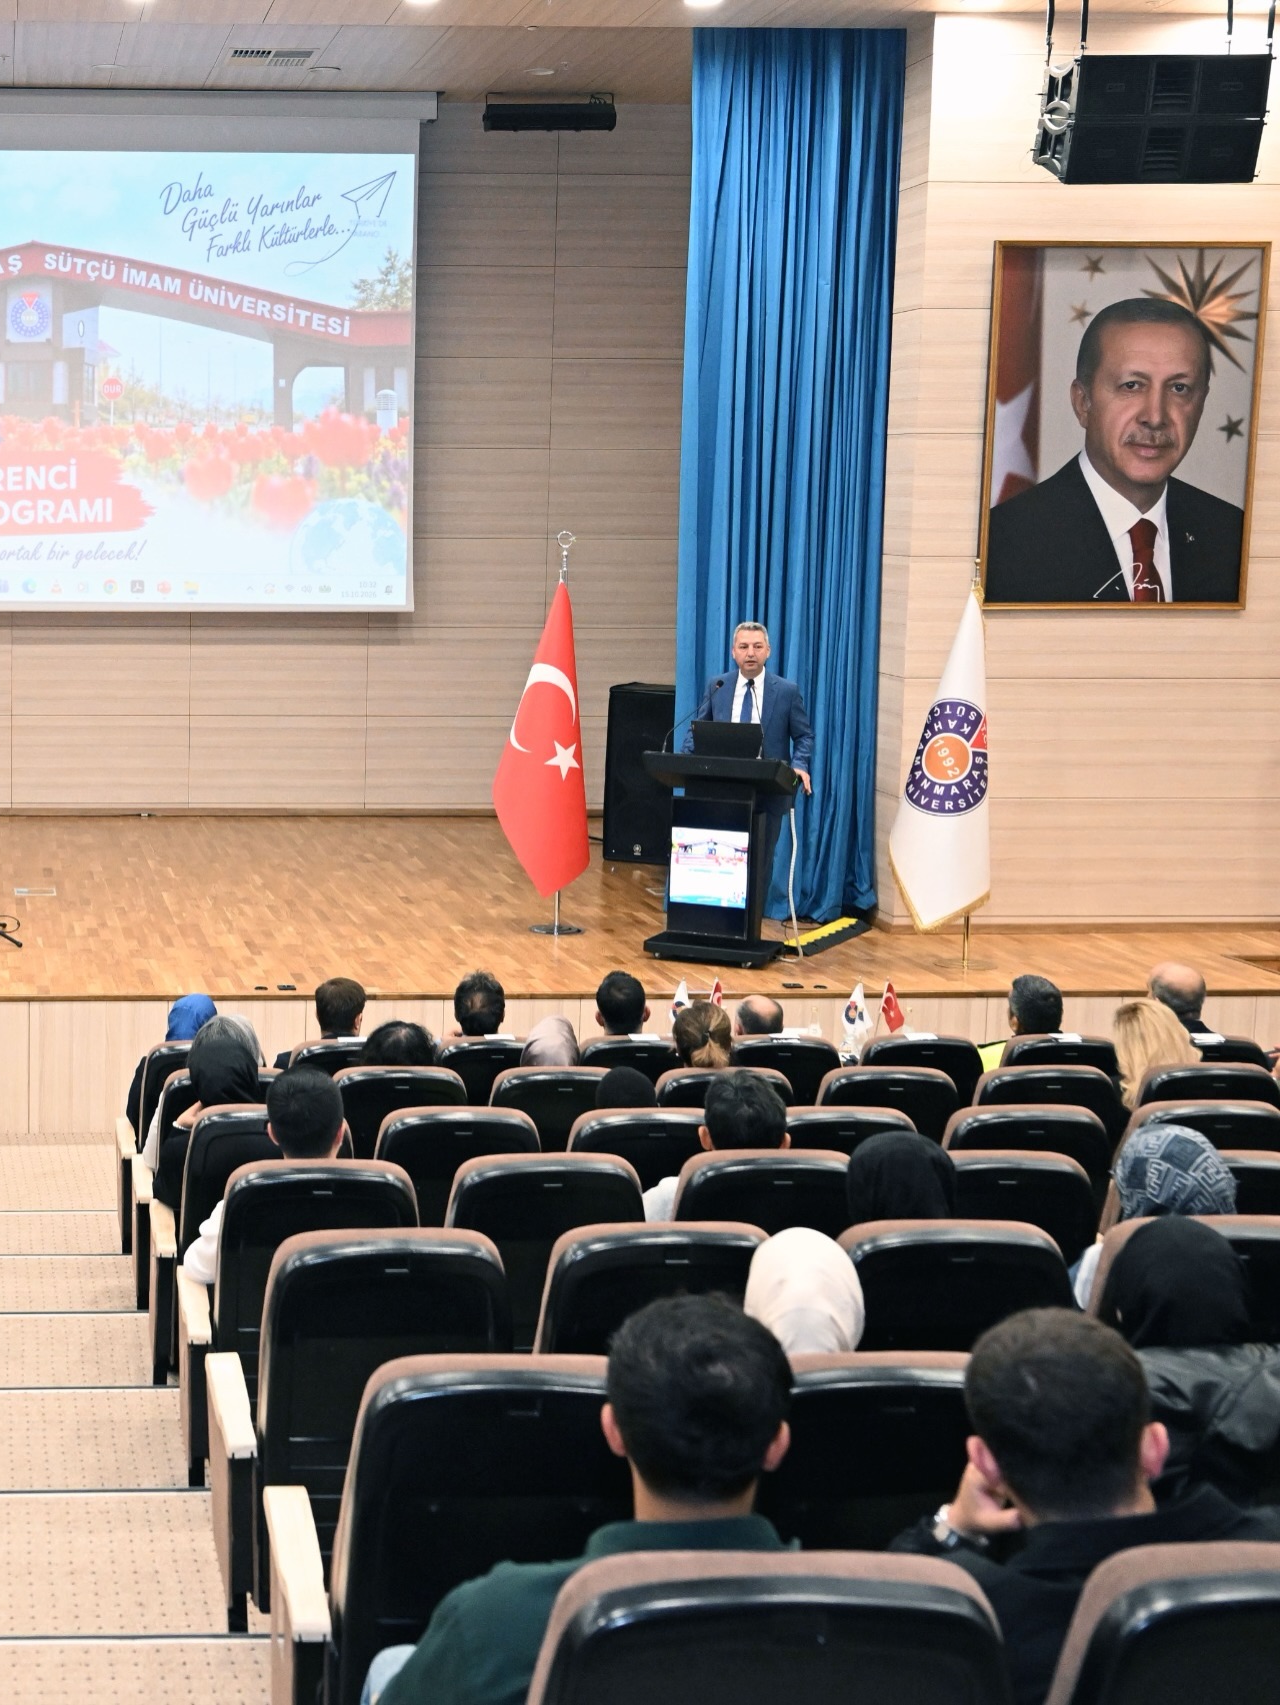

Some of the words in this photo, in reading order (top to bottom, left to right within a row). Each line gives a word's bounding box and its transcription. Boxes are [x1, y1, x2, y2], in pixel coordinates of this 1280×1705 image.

[160, 172, 214, 215] Daha
[182, 199, 238, 241] Güçlü
[247, 185, 323, 226] Yarınlar
[207, 232, 251, 263] Farklı
[258, 214, 352, 252] Kültürlerle...
[44, 252, 116, 281] SÜTÇÜ
[122, 263, 181, 296] İMAM
[189, 278, 351, 338] ÜNİVERSİTESİ
[104, 384, 122, 394] DUR
[47, 539, 70, 561] bir
[74, 538, 148, 569] gelecek!
[934, 739, 961, 778] 1992
